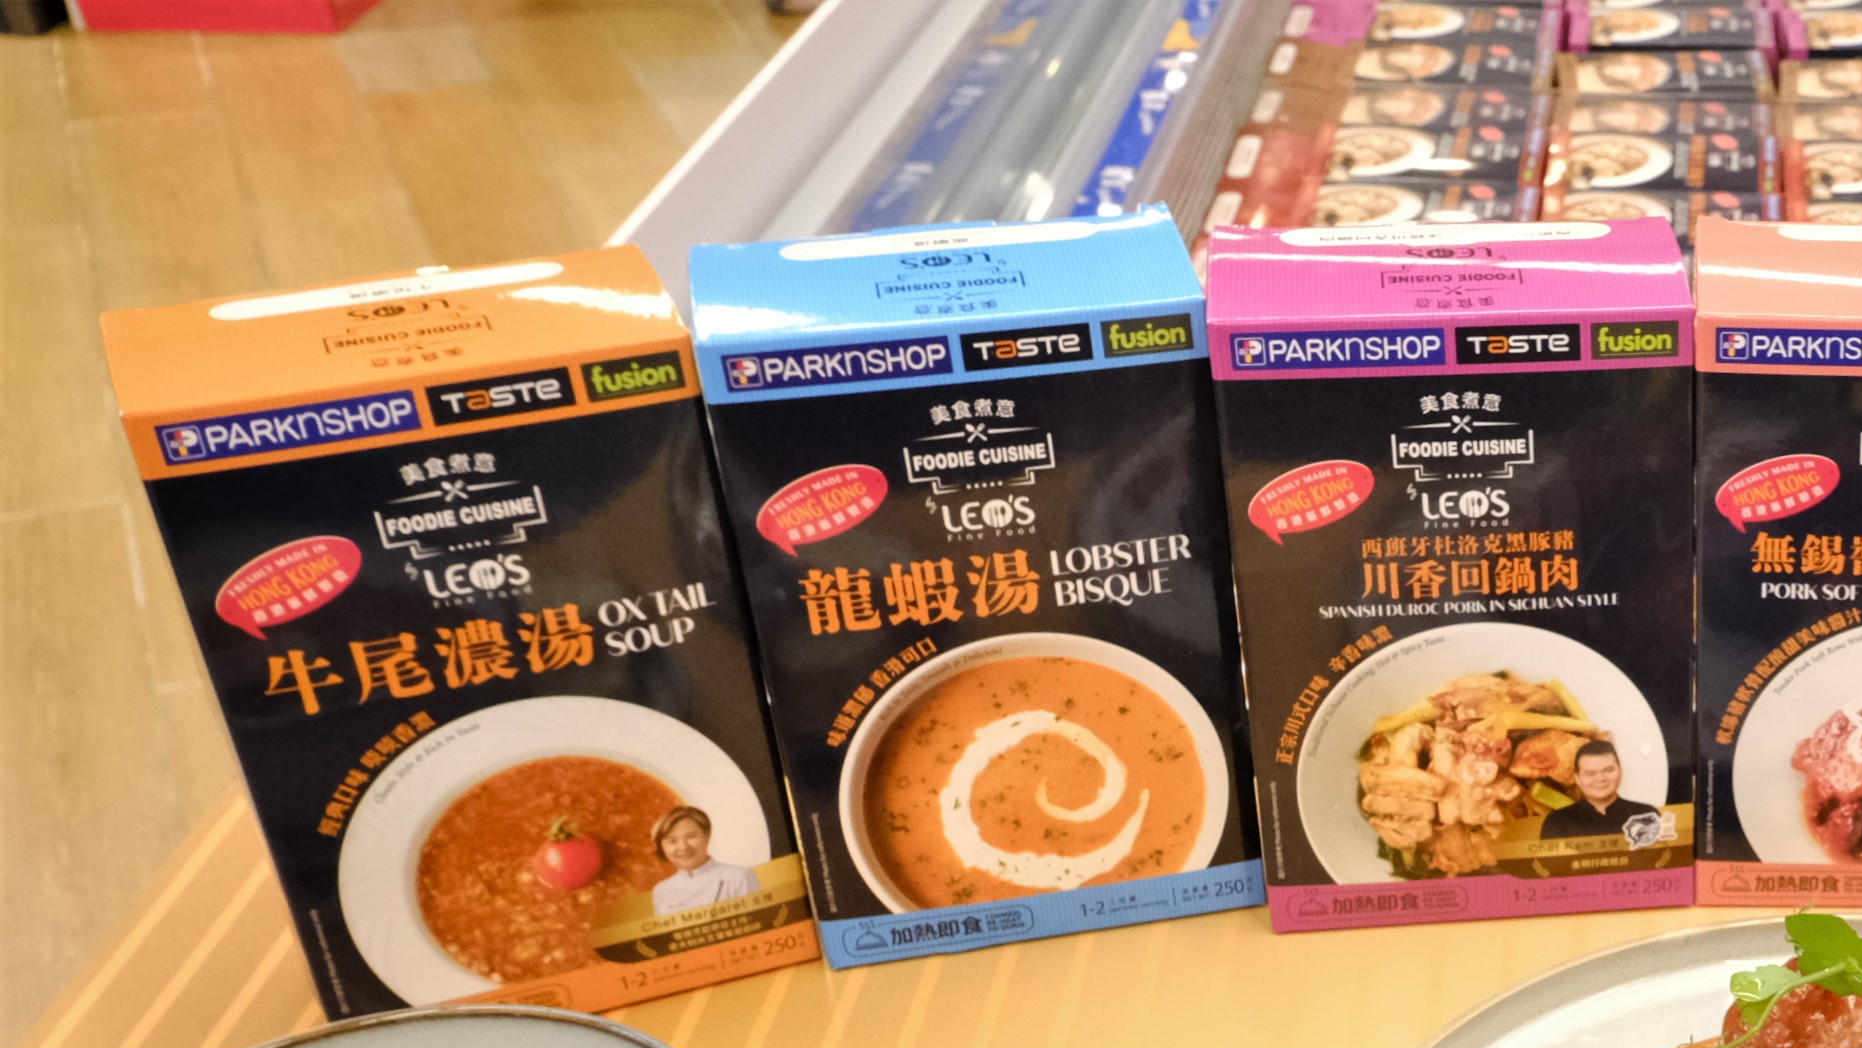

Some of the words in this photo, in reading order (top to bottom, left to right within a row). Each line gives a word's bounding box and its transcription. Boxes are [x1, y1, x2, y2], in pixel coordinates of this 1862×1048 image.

[1110, 322, 1186, 351] fusion
[1598, 327, 1672, 352] fusion
[591, 362, 677, 395] fusion
[930, 398, 1015, 425] 美食煮意
[1420, 391, 1502, 414] 美食煮意
[913, 449, 975, 472] FOODIE
[979, 443, 1046, 463] CUISINE
[1399, 440, 1457, 459] FOODIE
[1462, 438, 1526, 456] CUISINE
[1260, 477, 1300, 504] FRESHLY
[1302, 469, 1332, 484] MADE
[1335, 466, 1347, 476] IN
[1729, 468, 1769, 492] FRESHLY
[1772, 462, 1799, 474] MADE
[1803, 459, 1815, 469] IN
[1734, 480, 1777, 506] HONG
[1778, 471, 1820, 495] KONG
[775, 501, 821, 529] HONG
[823, 482, 867, 511] KONG
[1267, 492, 1311, 519] HONG
[1313, 477, 1354, 504] KONG
[386, 510, 455, 536] FOODIE
[459, 497, 535, 524] CUISINE
[1050, 534, 1191, 576] LOBSTER
[1361, 530, 1575, 558] 西班牙杜洛克黑豚豬
[238, 577, 291, 611] HONG
[294, 556, 338, 588] KONG
[798, 549, 1041, 635] 龍蝦湯
[1054, 568, 1172, 607] BISQUE
[1361, 554, 1580, 600] 川香回鍋肉
[1760, 582, 1818, 600] PORK
[599, 597, 645, 626] OX
[656, 583, 717, 616] TAIL
[1319, 602, 1384, 620] SPANISH
[1386, 600, 1439, 616] DUROC
[1444, 599, 1487, 614] PORK
[1489, 597, 1505, 612] IN
[1508, 595, 1574, 611] SICHUAN
[1576, 591, 1620, 607] STYLE
[605, 617, 695, 656] SOUP
[265, 602, 595, 715] 牛尾濃湯
[1081, 902, 1105, 917] 1-2
[1214, 880, 1244, 897] 250
[1643, 879, 1672, 894] 250
[1755, 875, 1840, 893] 加熱即食
[764, 935, 795, 956] 250
[890, 917, 982, 947] 加熱即食
